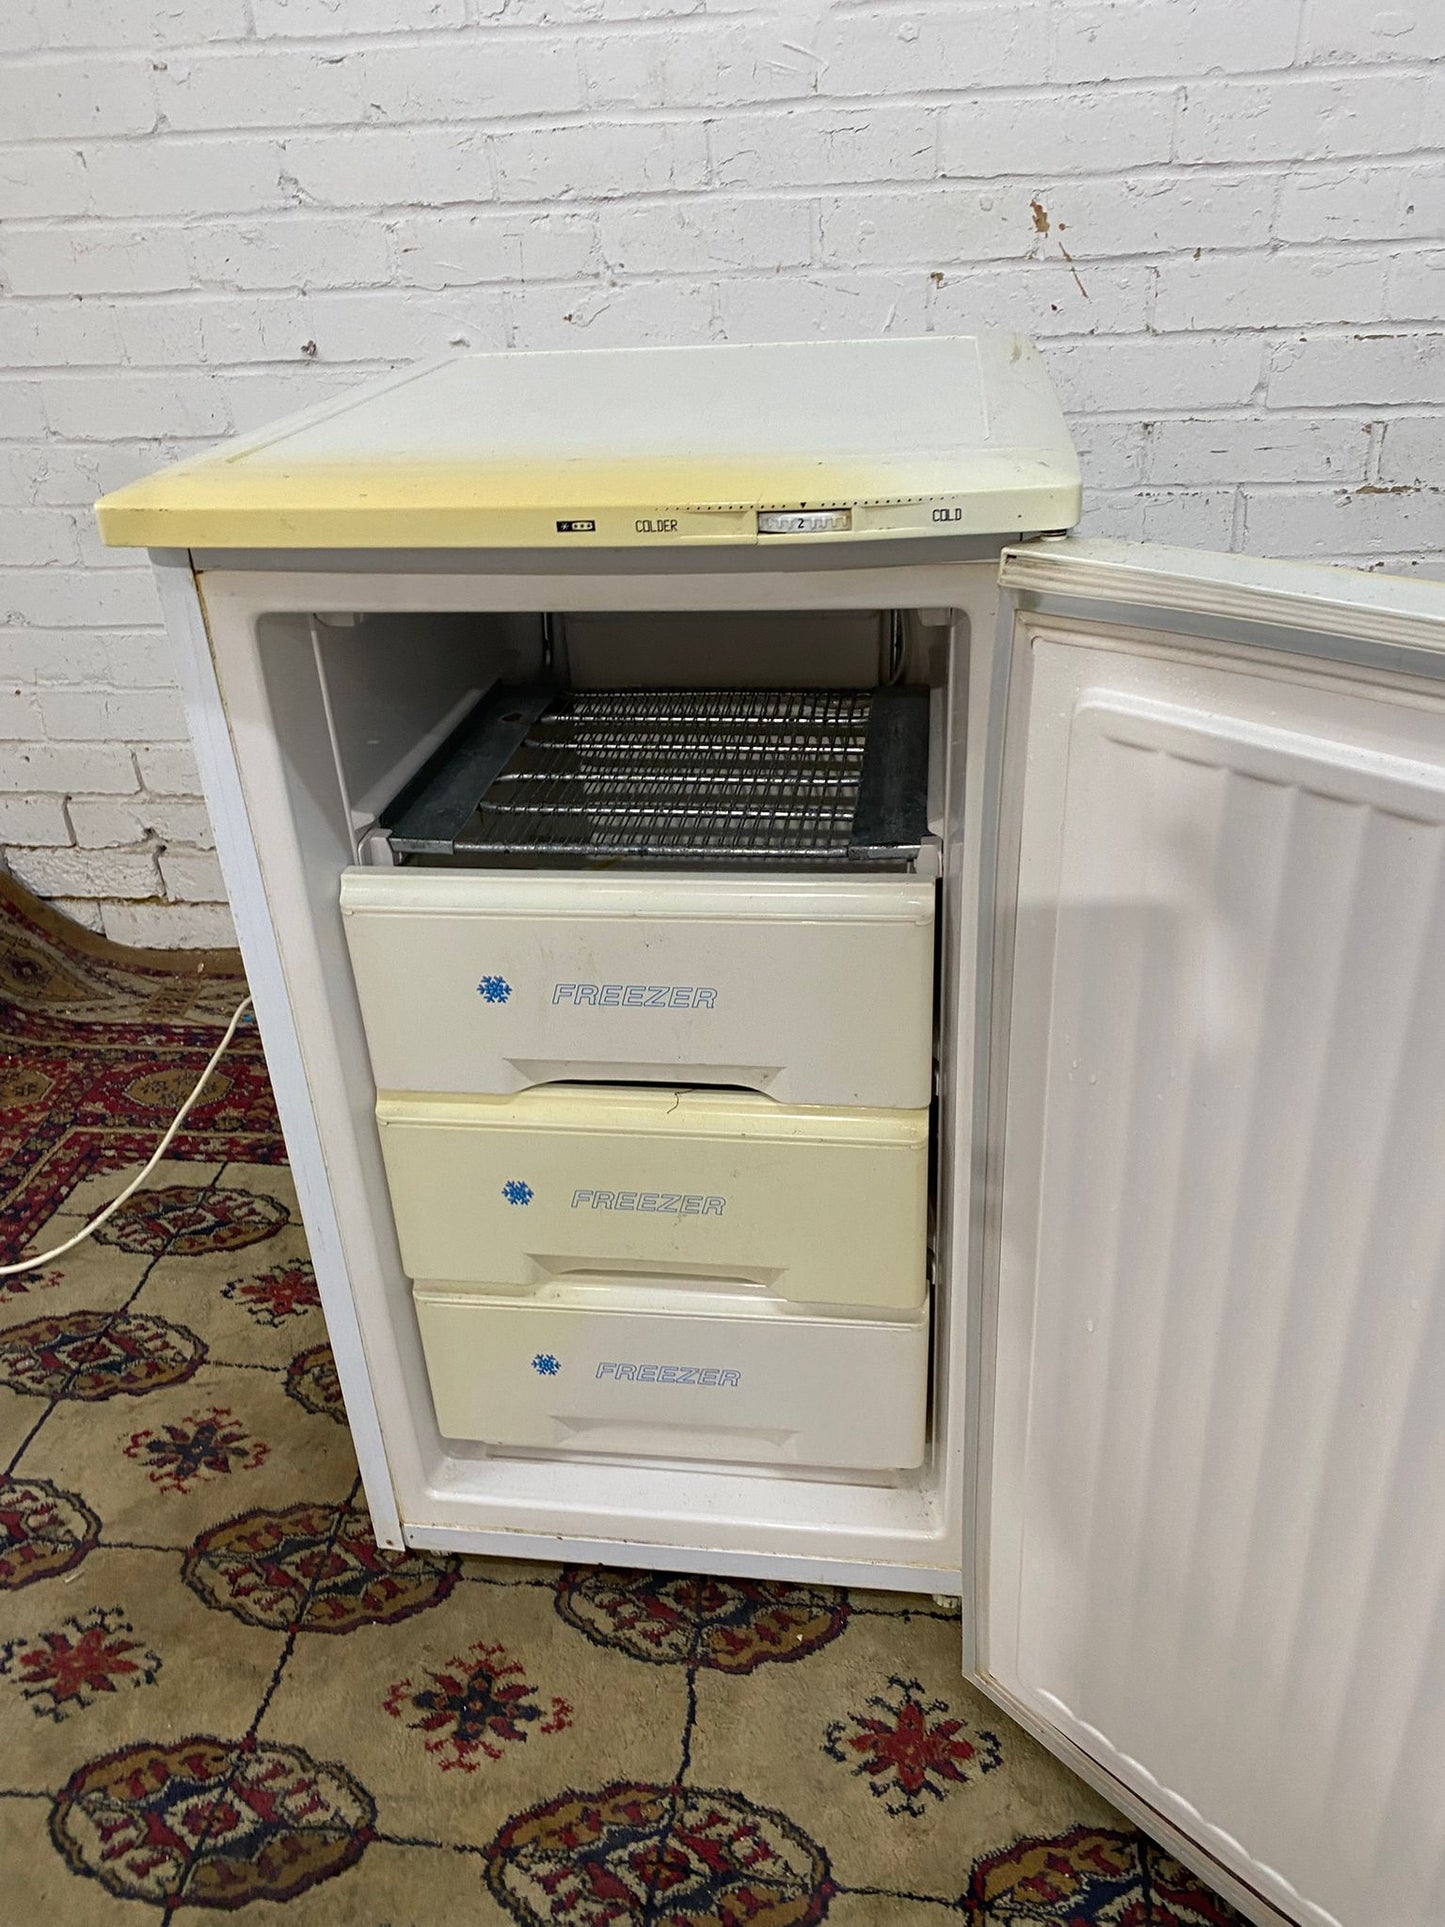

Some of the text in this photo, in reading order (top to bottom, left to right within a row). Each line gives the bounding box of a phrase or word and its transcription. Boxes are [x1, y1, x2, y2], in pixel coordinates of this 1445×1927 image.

[797, 518, 804, 529] 2
[932, 508, 962, 522] COLD
[635, 519, 678, 533] COLDER
[551, 983, 718, 1009] FREEZER
[570, 1189, 726, 1216] FREEZER
[595, 1362, 742, 1387] FREEZER
